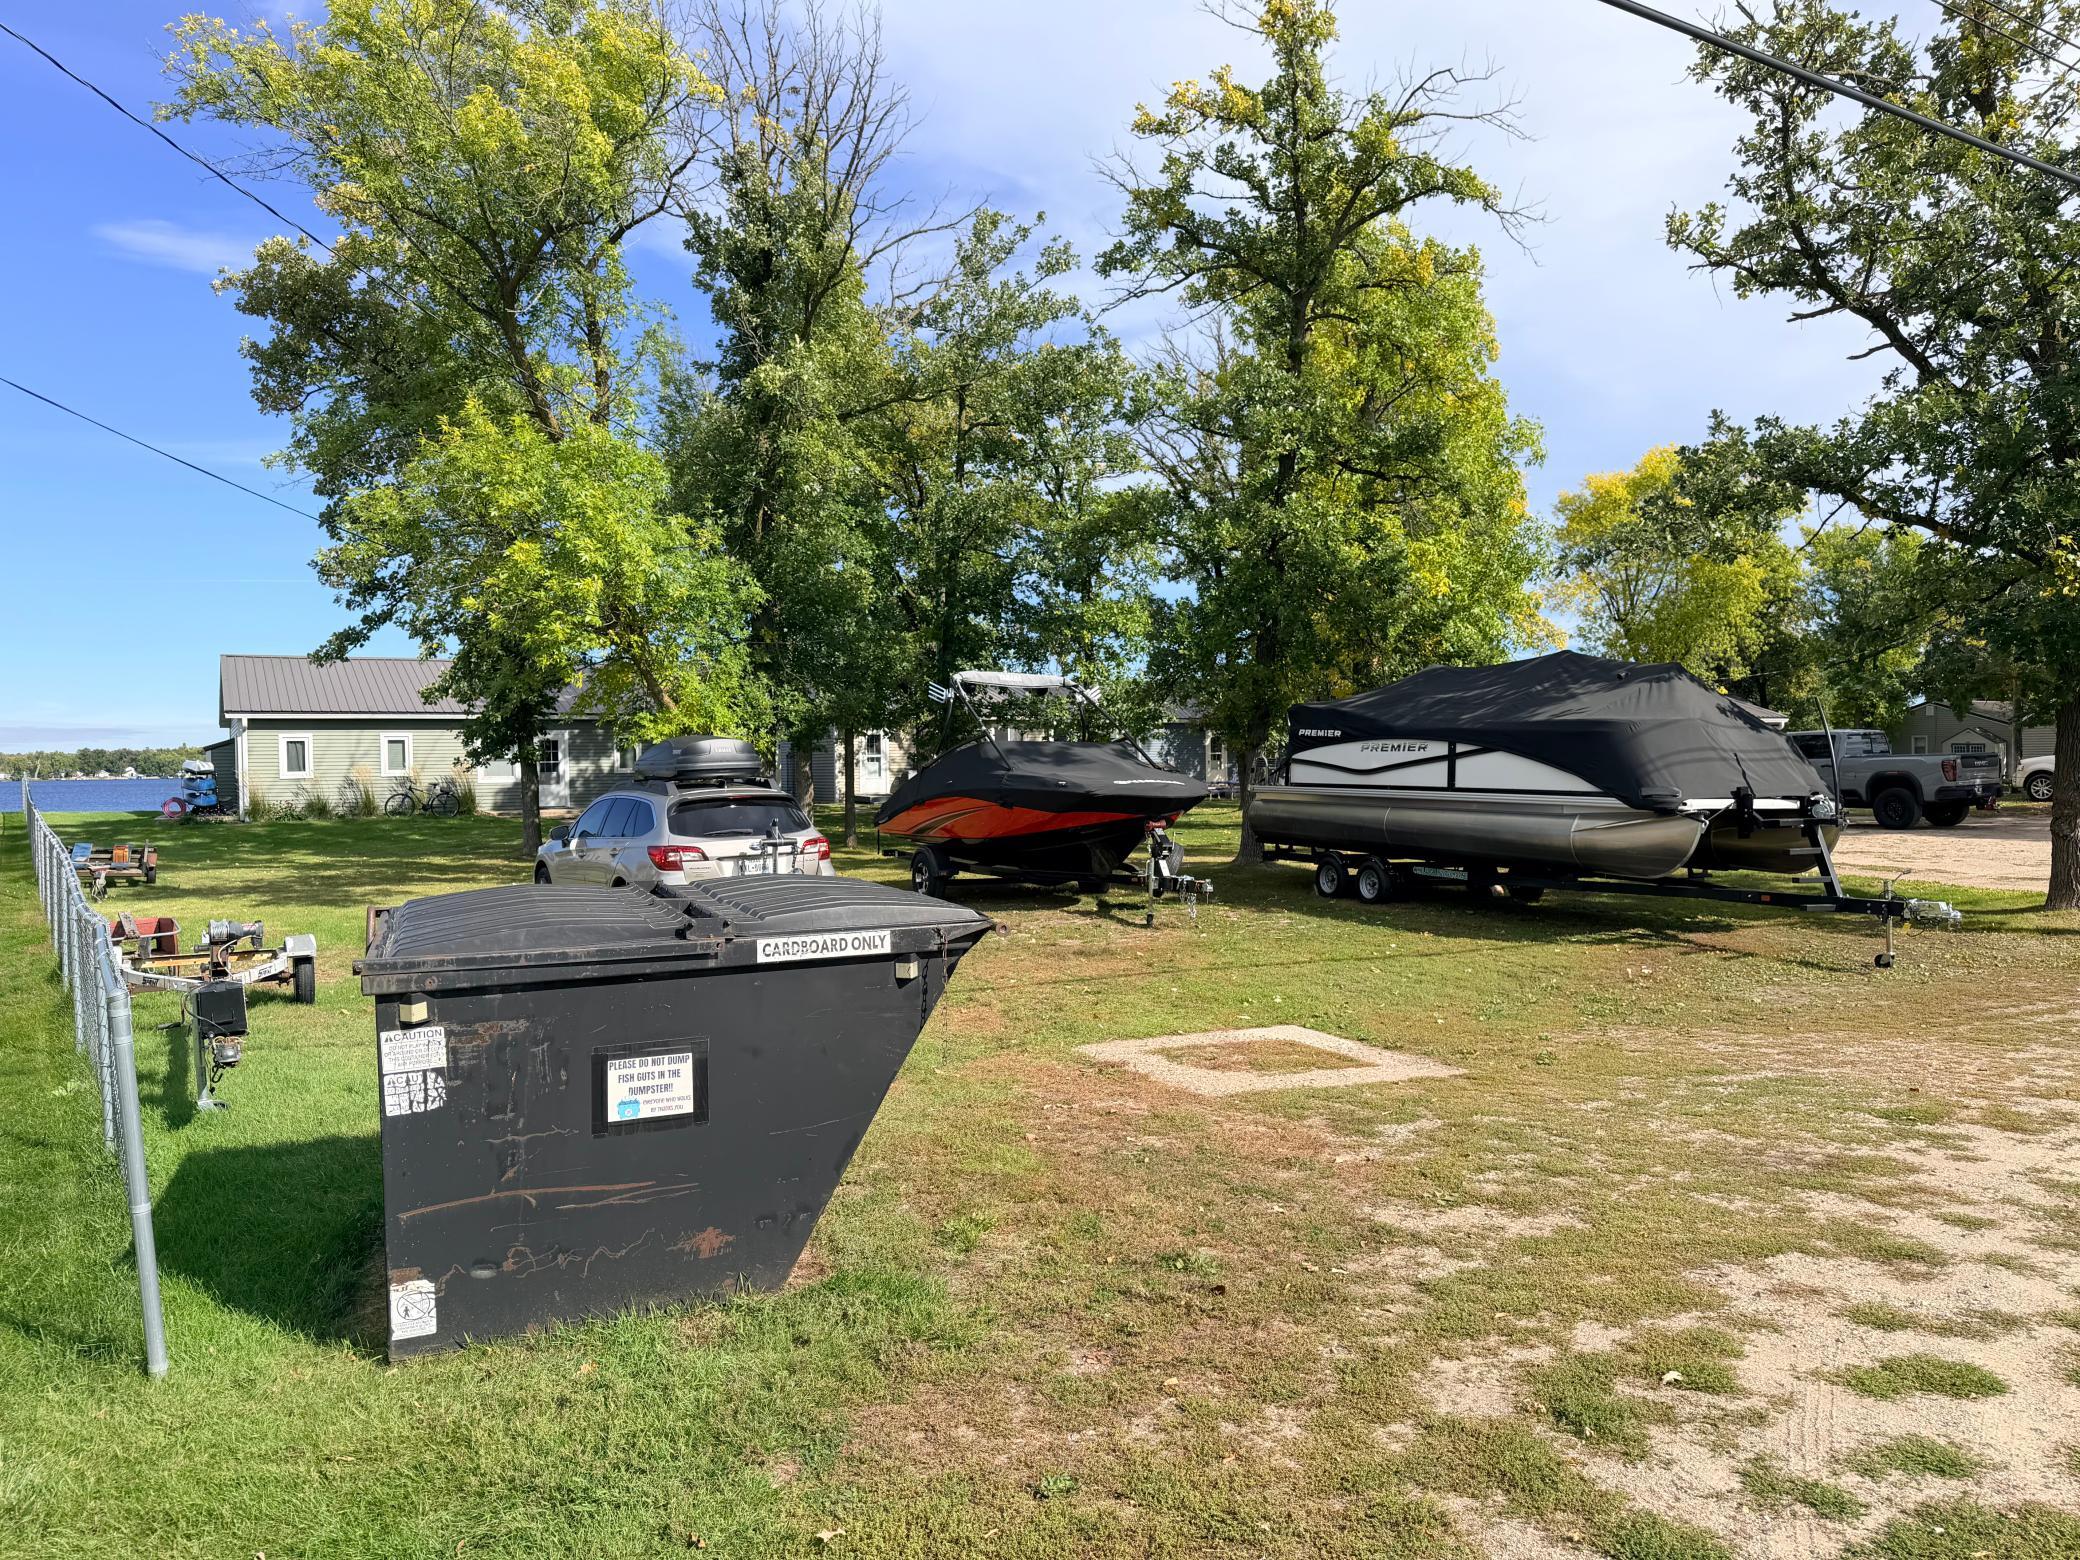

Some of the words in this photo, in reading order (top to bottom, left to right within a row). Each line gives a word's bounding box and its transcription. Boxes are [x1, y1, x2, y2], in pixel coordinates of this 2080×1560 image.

[1298, 729, 1341, 737] PREMIER
[1360, 742, 1428, 752] PREMIER
[762, 938, 848, 957] CARDBOARD
[851, 934, 887, 951] ONLY
[393, 1029, 442, 1042] CAUTION
[609, 1059, 637, 1071] PLEASE
[639, 1058, 649, 1068] DO
[651, 1057, 666, 1067] NOT
[667, 1055, 690, 1065] DUMP
[618, 1073, 635, 1084] FISH
[637, 1071, 656, 1082] GUTS
[658, 1070, 665, 1079] IN
[668, 1069, 681, 1078] THE
[628, 1083, 674, 1096] DUMPSTER!!
